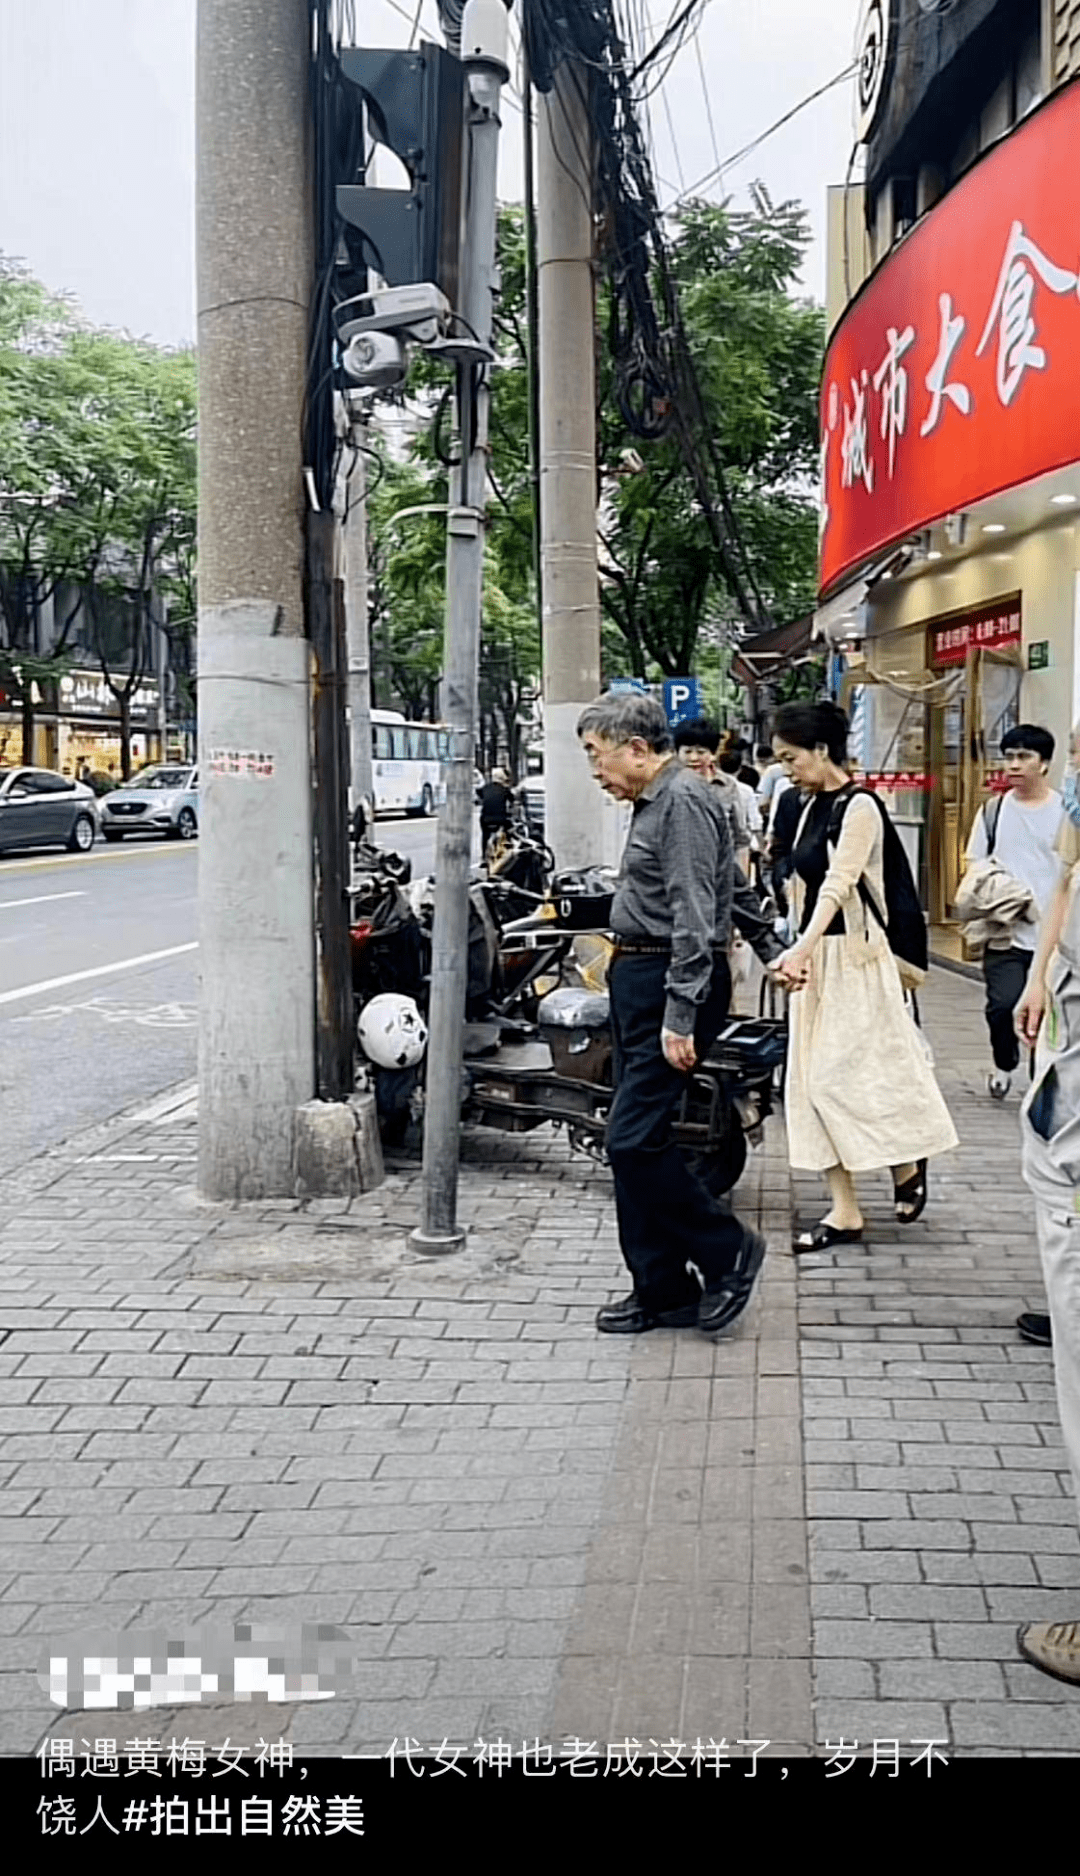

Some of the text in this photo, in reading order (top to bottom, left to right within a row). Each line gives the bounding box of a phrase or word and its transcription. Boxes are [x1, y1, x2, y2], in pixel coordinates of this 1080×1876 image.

[841, 220, 1080, 494] 城市大食
[671, 685, 690, 711] P
